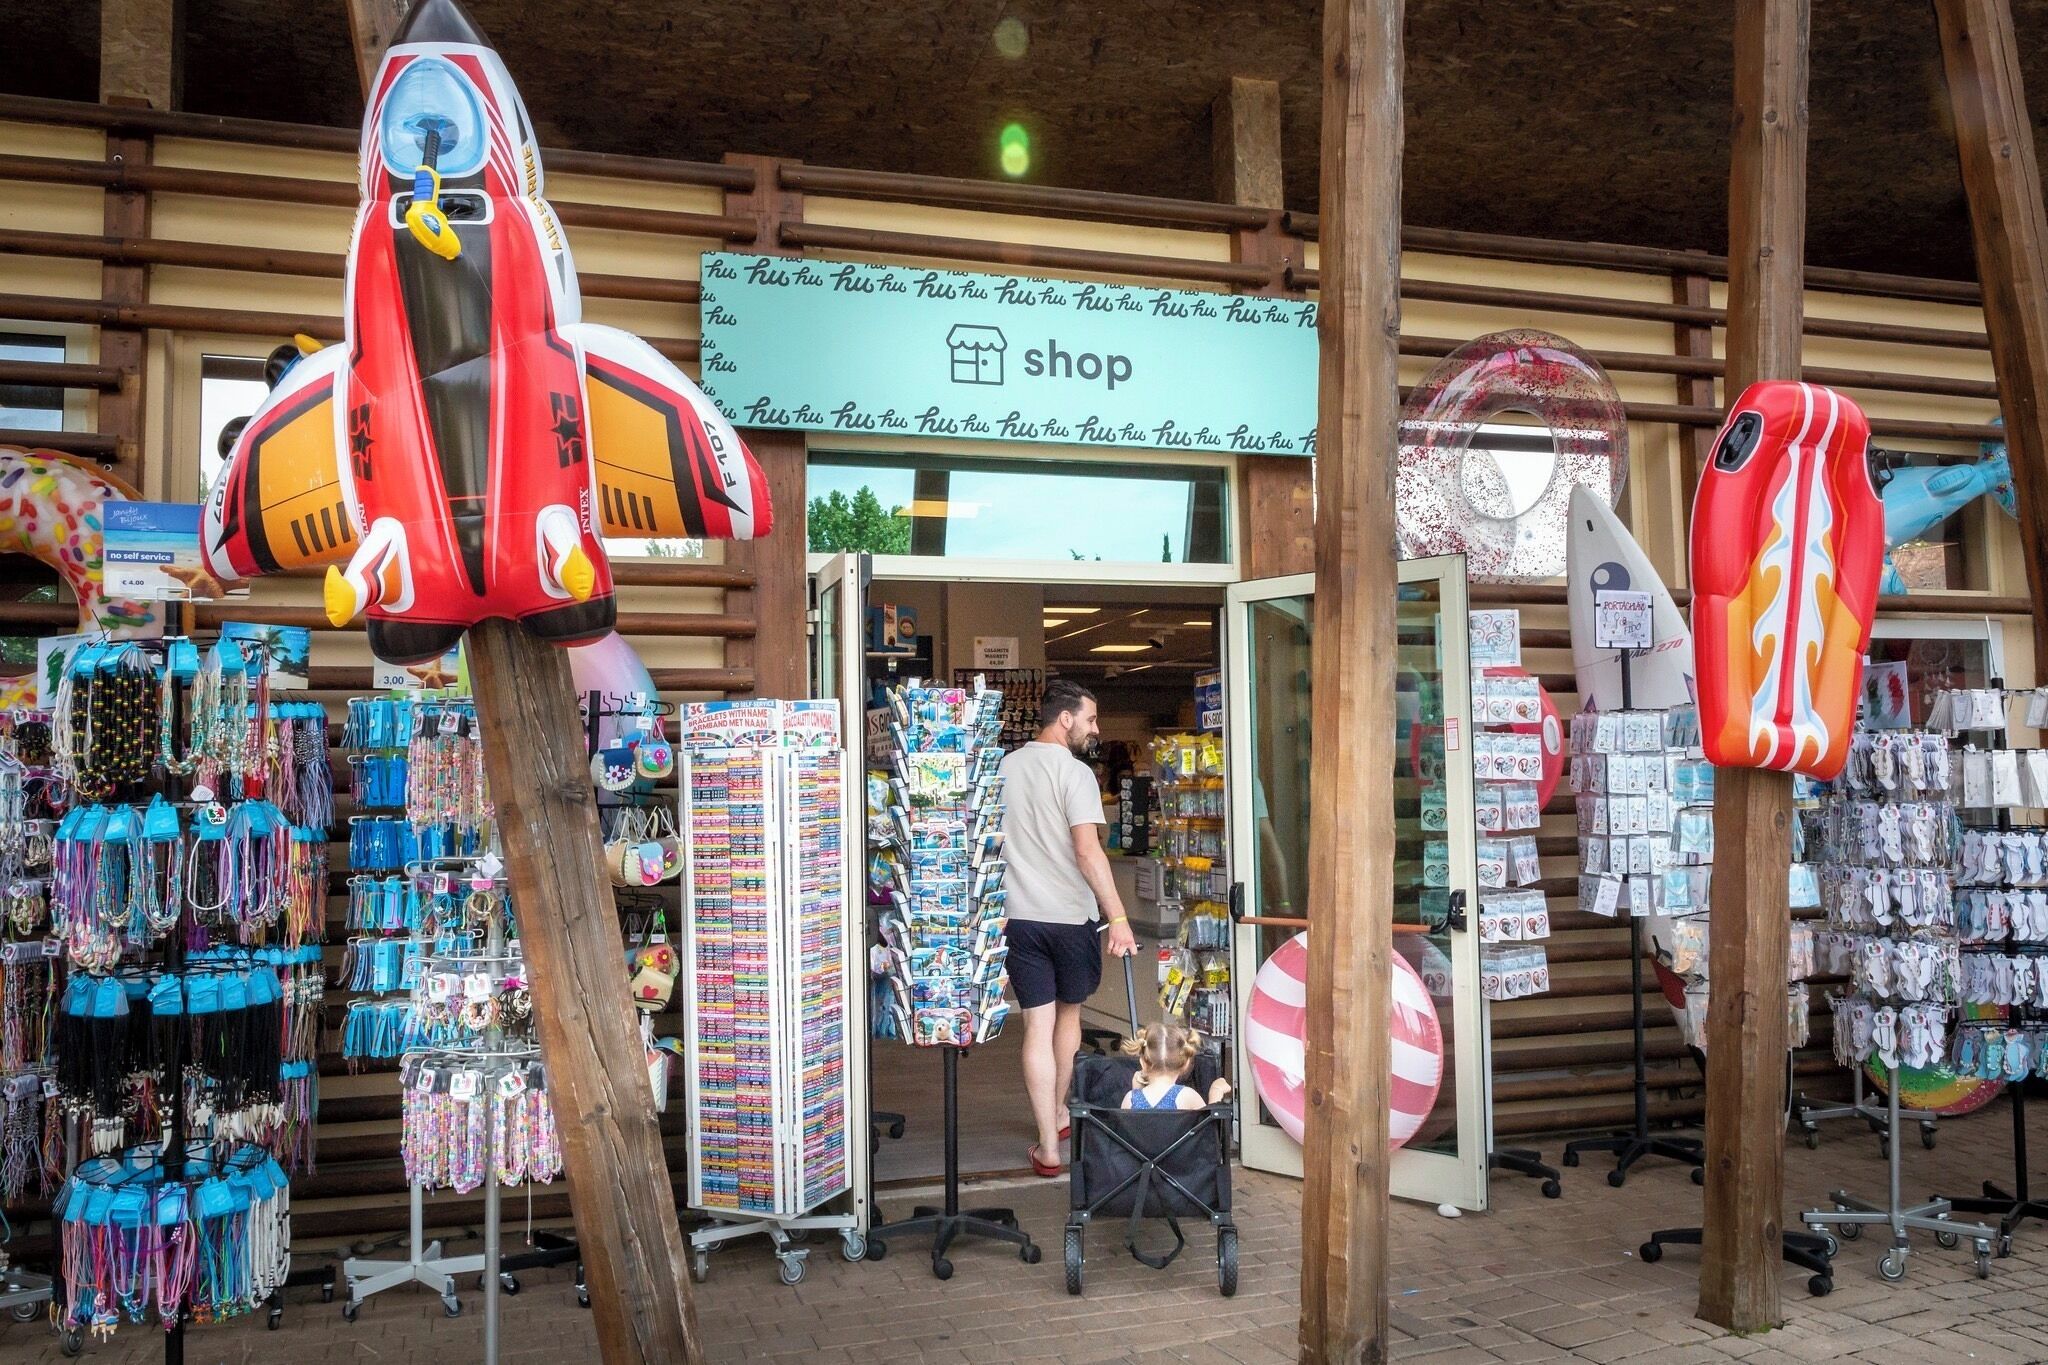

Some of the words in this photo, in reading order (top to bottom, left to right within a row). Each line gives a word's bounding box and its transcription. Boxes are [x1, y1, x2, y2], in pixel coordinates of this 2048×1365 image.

[704, 258, 738, 280] hu
[743, 257, 791, 287] hu
[791, 266, 824, 287] hu
[829, 264, 875, 294] hu
[876, 273, 907, 293] hu
[913, 271, 957, 300] hu
[958, 280, 988, 300] hu
[994, 278, 1036, 306] hu
[1038, 286, 1067, 306] hu
[1072, 284, 1114, 312] hu
[1115, 293, 1143, 312] hu
[1148, 291, 1189, 318] hu
[1190, 299, 1217, 318] hu
[1222, 297, 1262, 324] hu
[1262, 305, 1290, 324] hu
[704, 305, 737, 326] hu
[704, 352, 737, 373] hu
[1025, 340, 1133, 390] shop
[743, 396, 791, 426] hu
[792, 403, 824, 424] hu
[830, 401, 876, 430] hu
[877, 408, 908, 429] hu
[914, 406, 958, 434] hu
[960, 413, 990, 433] hu
[996, 411, 1039, 439] hu
[1040, 418, 1069, 437] hu
[1075, 415, 1117, 443] hu
[1118, 422, 1146, 441] hu
[1152, 420, 1192, 447] hu
[1193, 427, 1221, 445] hu
[1226, 424, 1266, 451] hu
[1266, 431, 1294, 450] hu
[703, 420, 729, 466] 107
[580, 488, 591, 534] INTEX
[123, 552, 139, 561] self
[140, 553, 171, 562] service
[1656, 638, 1684, 653] 270
[383, 676, 404, 686] 3,00
[688, 711, 727, 728] BRACELETS
[728, 710, 748, 719] WITH
[747, 708, 768, 719] NAME
[692, 720, 728, 732] ARMBAND
[728, 719, 743, 728] MET
[744, 718, 768, 729] NAAM
